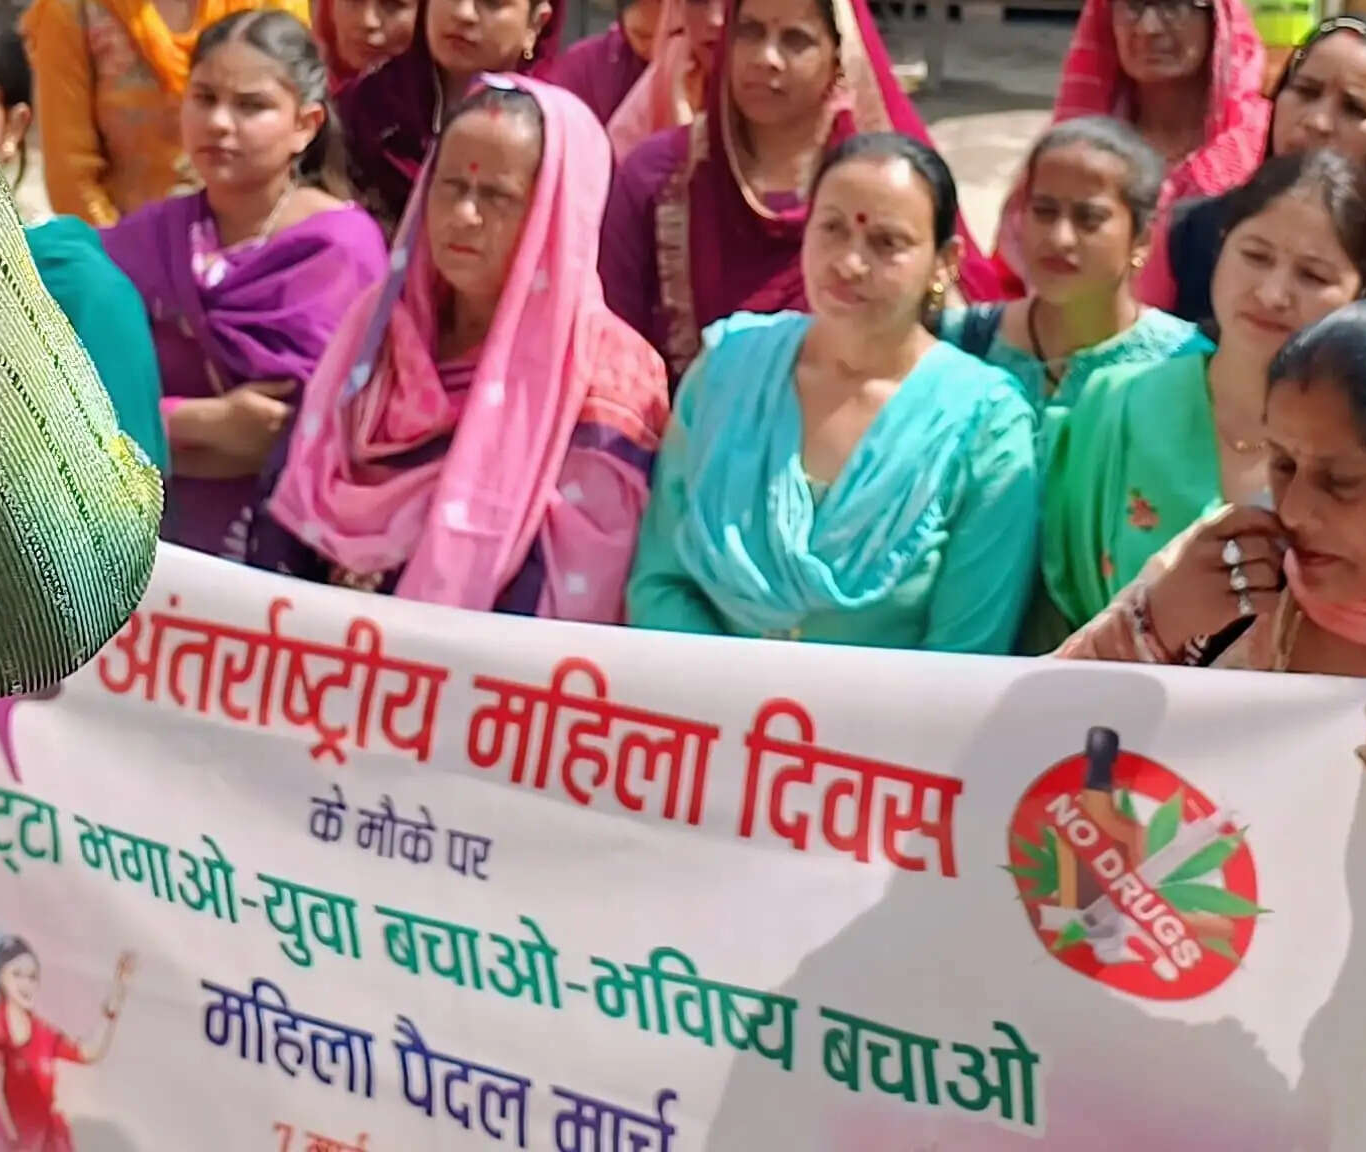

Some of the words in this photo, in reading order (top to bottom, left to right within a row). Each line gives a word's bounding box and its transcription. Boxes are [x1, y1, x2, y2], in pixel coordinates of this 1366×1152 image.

[97, 594, 449, 764] अंतर्राष्ट्रीय
[467, 656, 720, 826] महिला
[739, 697, 964, 879] दिवस
[309, 783, 347, 843] के
[356, 794, 437, 864] मौके
[447, 828, 493, 881] पर
[1045, 793, 1100, 847] NO
[1091, 847, 1204, 970] DRUGS
[74, 814, 362, 968] भगाओ-युवा
[374, 904, 800, 1072] बचाओ-भविष्य
[818, 1004, 1041, 1127] बचाओ
[200, 976, 375, 1099] महिला
[390, 1014, 533, 1149] पैदल
[550, 1088, 679, 1152] मार्च
